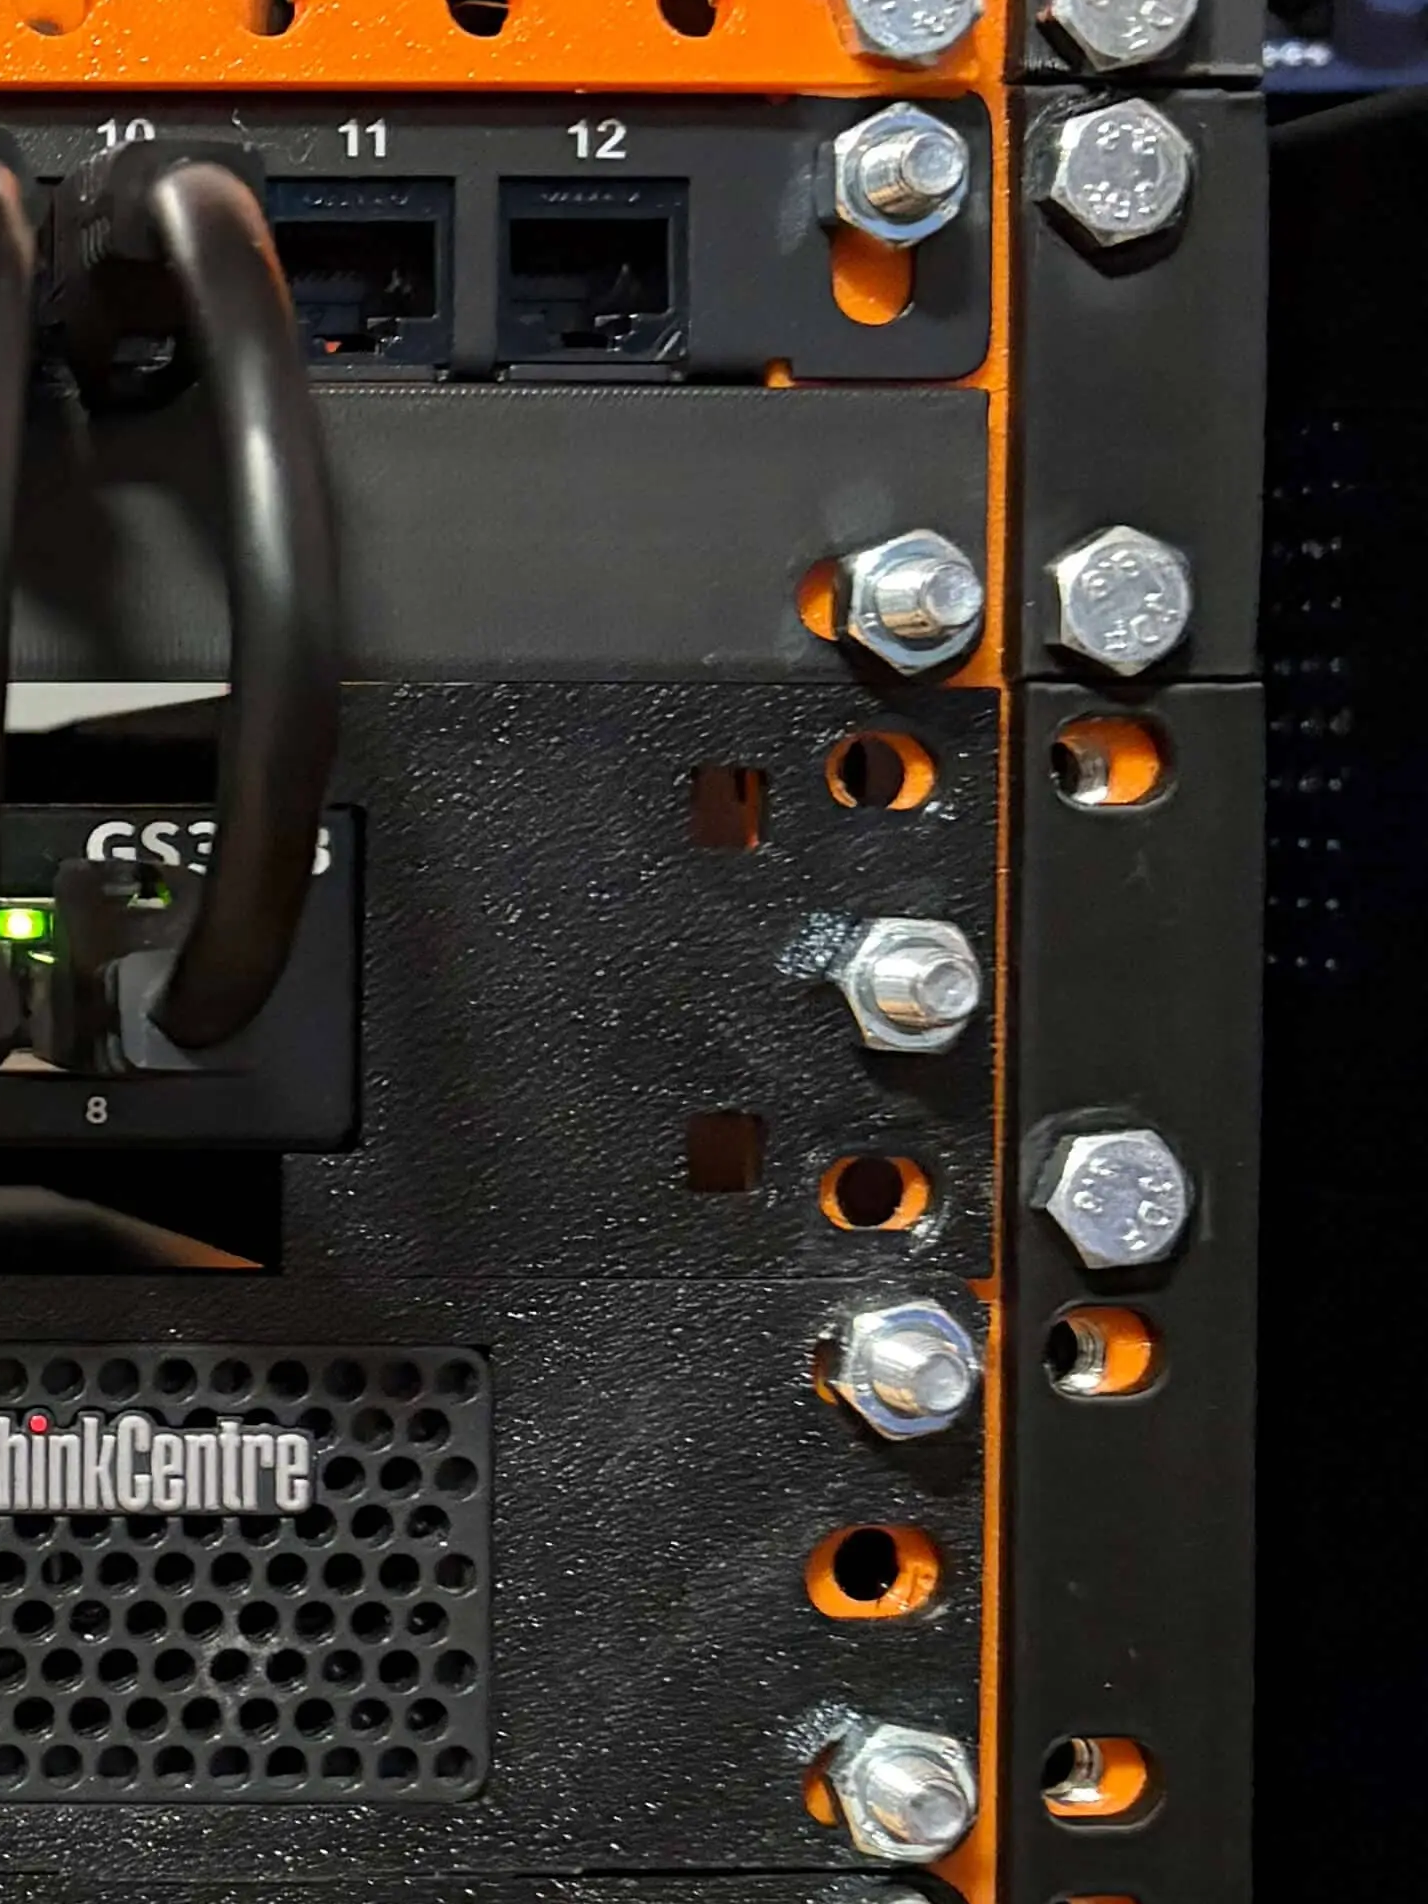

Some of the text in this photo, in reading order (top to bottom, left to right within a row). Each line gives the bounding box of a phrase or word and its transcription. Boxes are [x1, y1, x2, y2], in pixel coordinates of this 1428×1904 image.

[97, 118, 156, 149] 10
[338, 119, 386, 157] 11
[567, 119, 627, 159] 12
[86, 1096, 108, 1124] 8
